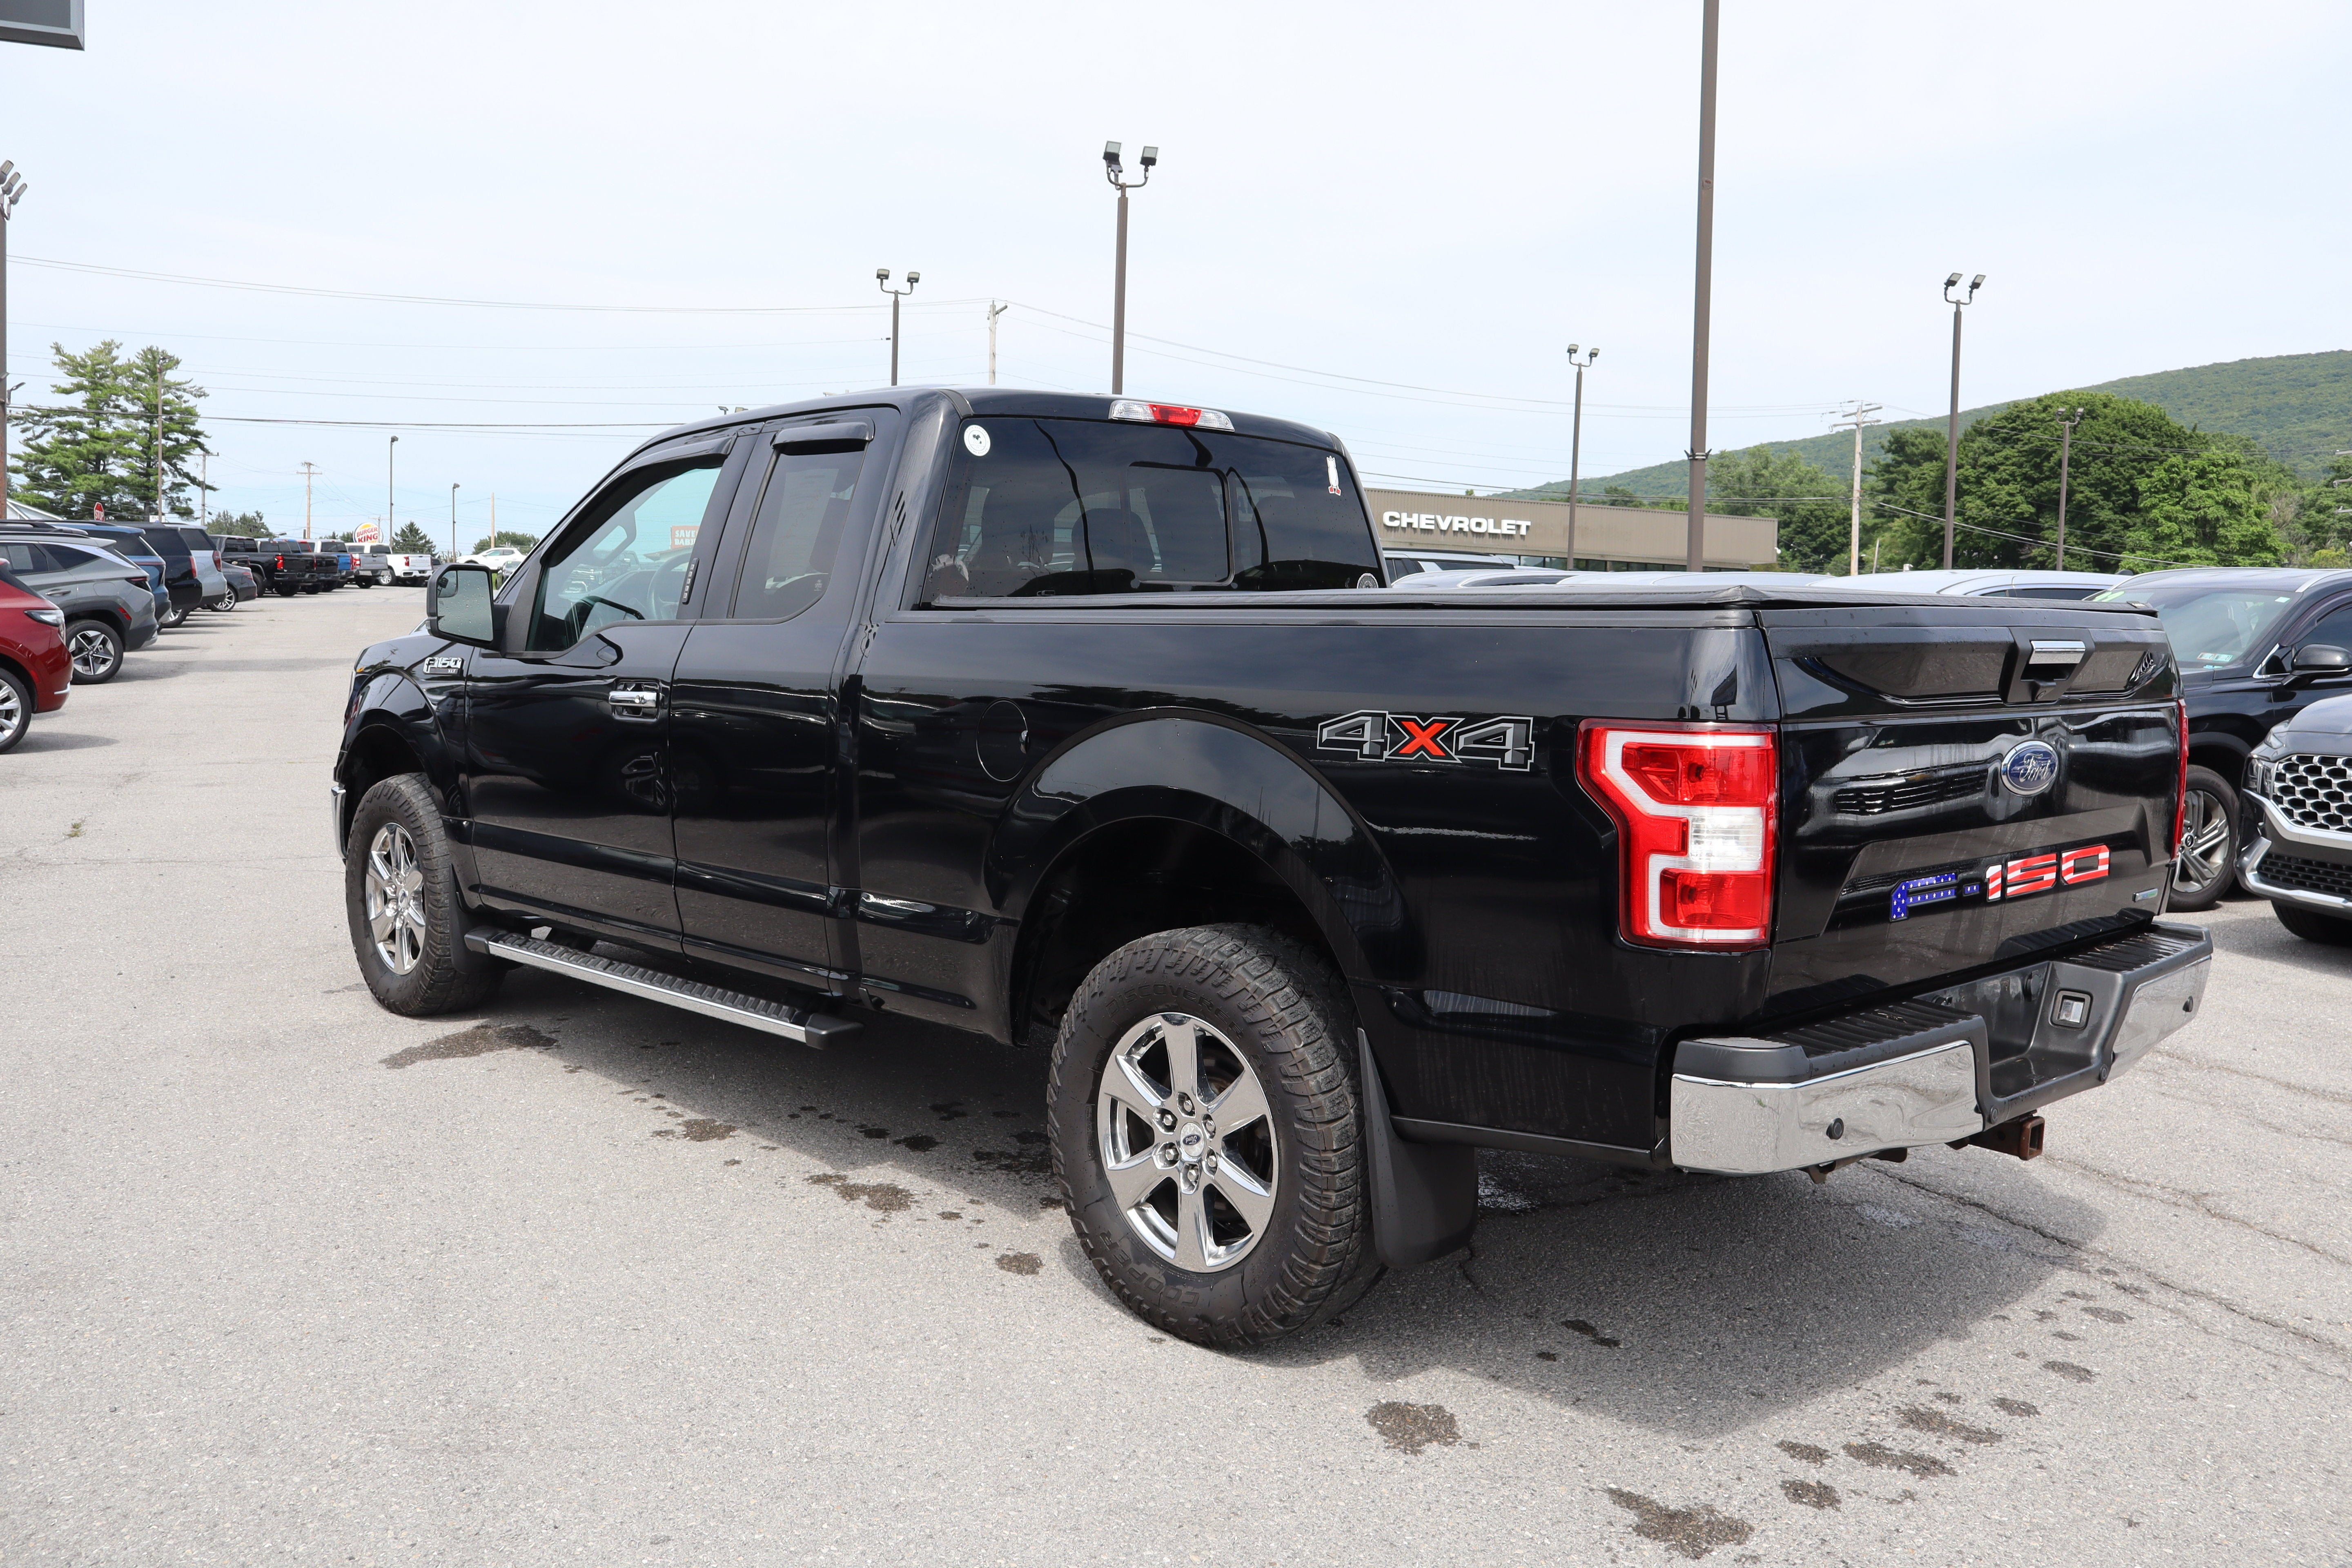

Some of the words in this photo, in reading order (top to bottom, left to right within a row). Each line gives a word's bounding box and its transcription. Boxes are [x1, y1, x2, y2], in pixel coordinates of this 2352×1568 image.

[96, 510, 104, 521] STOP
[1383, 511, 1531, 535] CHEVROLET
[357, 527, 377, 537] BURGER
[358, 533, 378, 543] KING
[1317, 710, 1535, 772] 4X4
[2019, 753, 2051, 783] Ford
[1890, 844, 2109, 921] F-150
[1105, 984, 1244, 1040] DISCOVERER
[1185, 1135, 1197, 1145] Ford
[1099, 1229, 1200, 1307] COOPER
